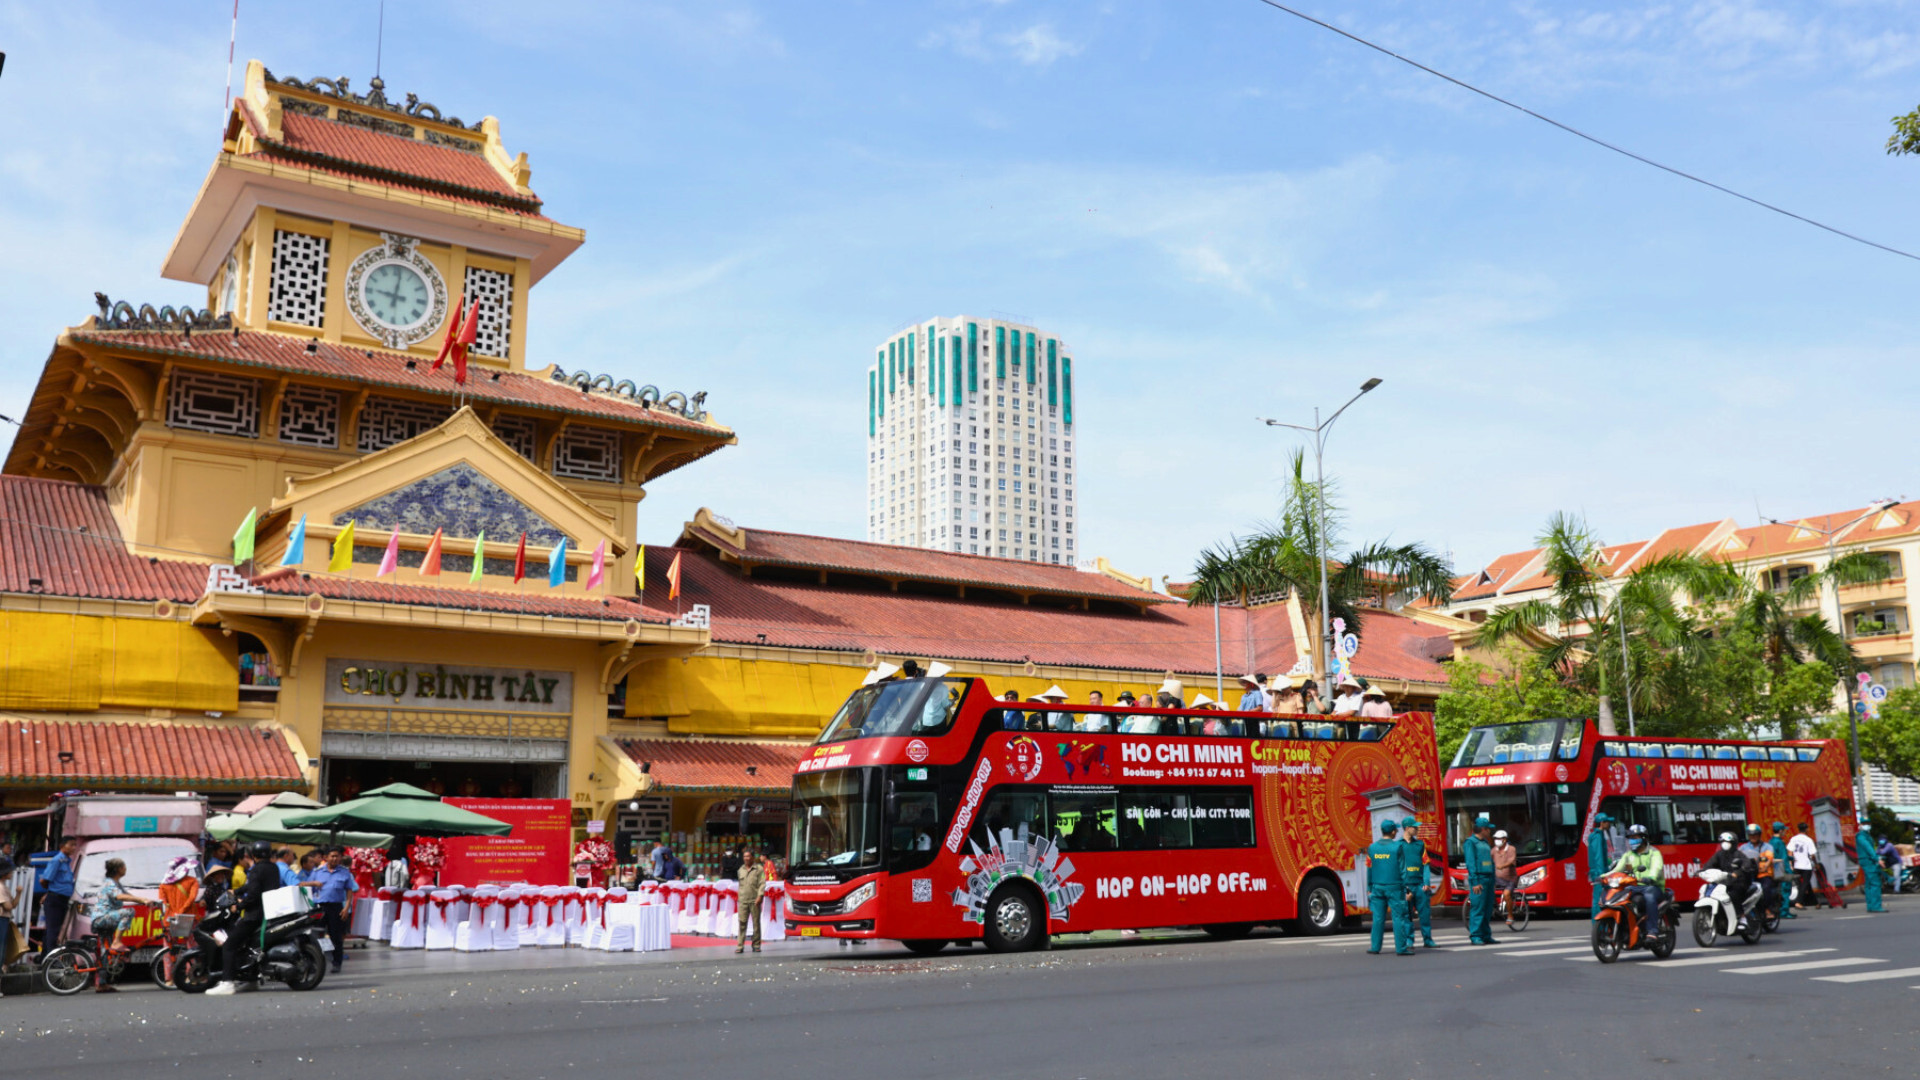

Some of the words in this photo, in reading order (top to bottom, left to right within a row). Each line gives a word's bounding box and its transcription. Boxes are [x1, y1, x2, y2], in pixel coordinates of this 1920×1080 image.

[341, 665, 409, 703] CHỢ
[415, 664, 495, 700] BÌNH
[501, 671, 559, 703] TÂY
[1121, 742, 1151, 763] HO
[1155, 743, 1190, 764] CHI
[1193, 744, 1243, 764] MINH
[1283, 748, 1311, 761] TOUR
[798, 759, 811, 772] HO
[811, 756, 826, 769] CHI
[826, 753, 851, 768] MINH
[1123, 766, 1164, 779] Booking:
[1167, 767, 1185, 777] +84
[1187, 768, 1204, 778] 913
[1206, 768, 1218, 778] 67
[1219, 768, 1232, 778] 44
[1234, 768, 1245, 778] 12
[1670, 764, 1687, 780] HO
[1688, 765, 1708, 779] CHI
[1709, 765, 1738, 780] MINH
[1453, 778, 1467, 787] HO
[1469, 776, 1486, 786] CHI
[1487, 774, 1515, 784] MINH
[575, 793, 591, 802] 57A
[946, 823, 964, 854] HOP
[977, 757, 992, 783] OFF
[1208, 808, 1227, 819] CITY
[1229, 808, 1251, 818] TOUR
[1096, 876, 1134, 898] HOP
[1140, 873, 1211, 897] ON-HOP
